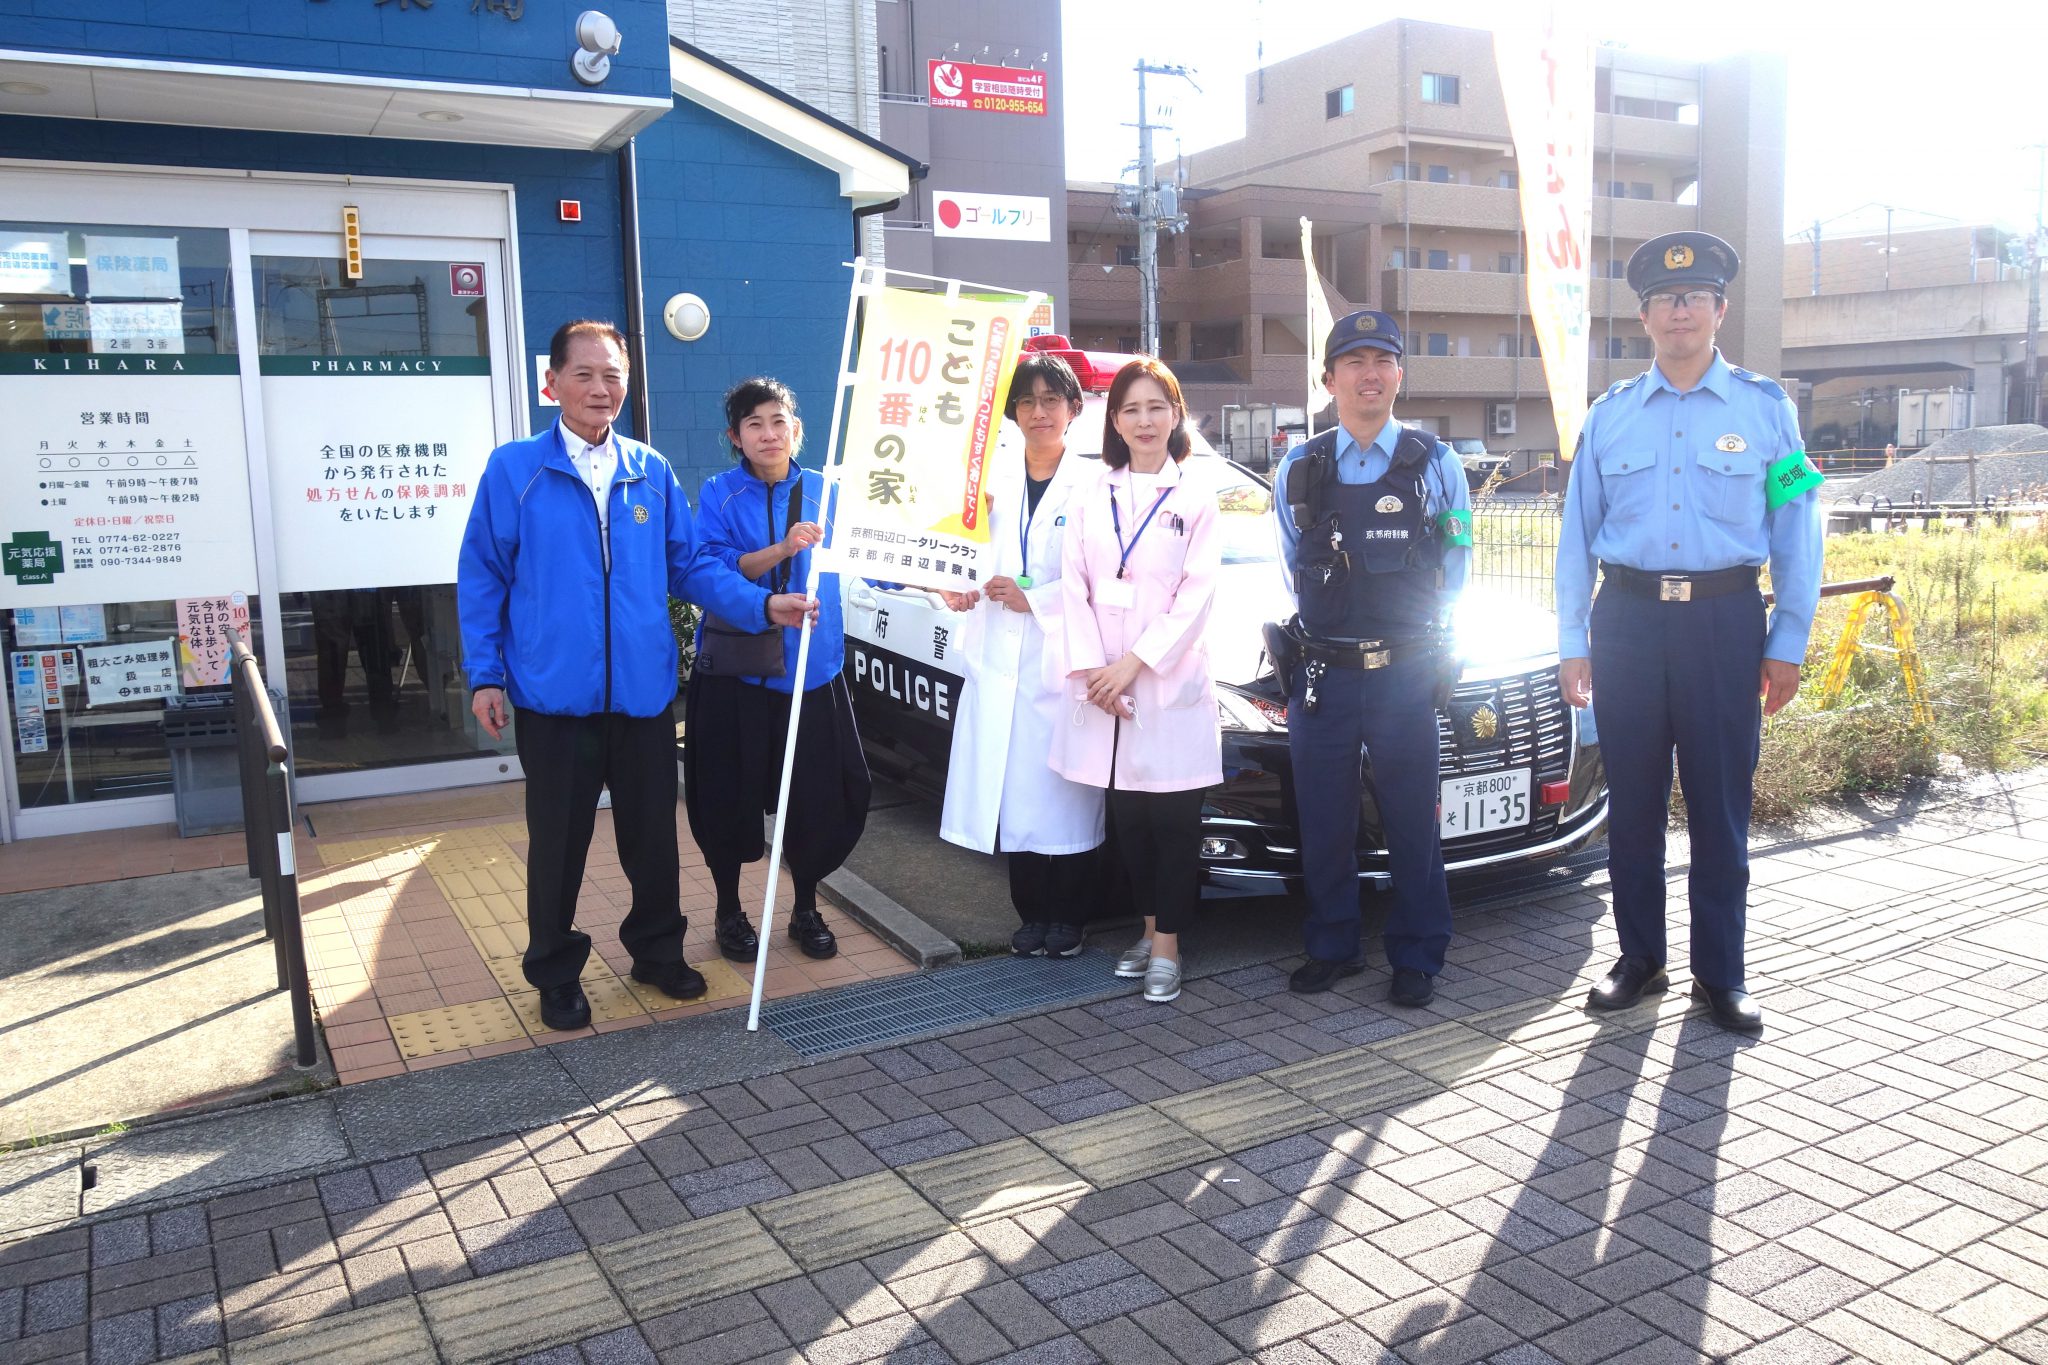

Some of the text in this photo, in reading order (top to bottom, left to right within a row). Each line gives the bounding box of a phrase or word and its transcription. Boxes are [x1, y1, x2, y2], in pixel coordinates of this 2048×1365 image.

[984, 97, 1044, 114] 0120-955-654
[965, 206, 1046, 226] ゴールフリー
[95, 255, 169, 272] 保険薬局
[33, 358, 185, 371] KIHARA
[312, 360, 443, 372] PHARMACY
[934, 318, 976, 426] こども
[80, 411, 151, 425] 営業時間
[39, 438, 193, 450] 月 火 水 木 金 土
[320, 443, 448, 460] 全国の医療機関
[324, 463, 447, 481] から発行された
[1777, 463, 1807, 489] 地域
[50, 498, 67, 506] 土曜
[306, 484, 467, 503] 処方せんの保険調剤
[339, 505, 438, 522] をいたします
[72, 533, 181, 544] TEL 0774-62-0227
[1366, 529, 1409, 539] 京都府警察
[8, 546, 57, 560] 元気応援
[73, 543, 181, 556] FAX 0774-62-2876
[22, 558, 46, 569] 薬局
[101, 556, 182, 567] 090-7344-9849
[22, 573, 41, 581] class
[187, 602, 203, 649] 元気な体
[216, 600, 230, 635] 秋の空
[201, 600, 218, 670] 今日も歩いて
[87, 651, 170, 669] 粗大ごみ処理券
[132, 684, 172, 695] 京田辺市
[855, 650, 950, 721] POLICE
[1446, 792, 1526, 831] そ 11-35
